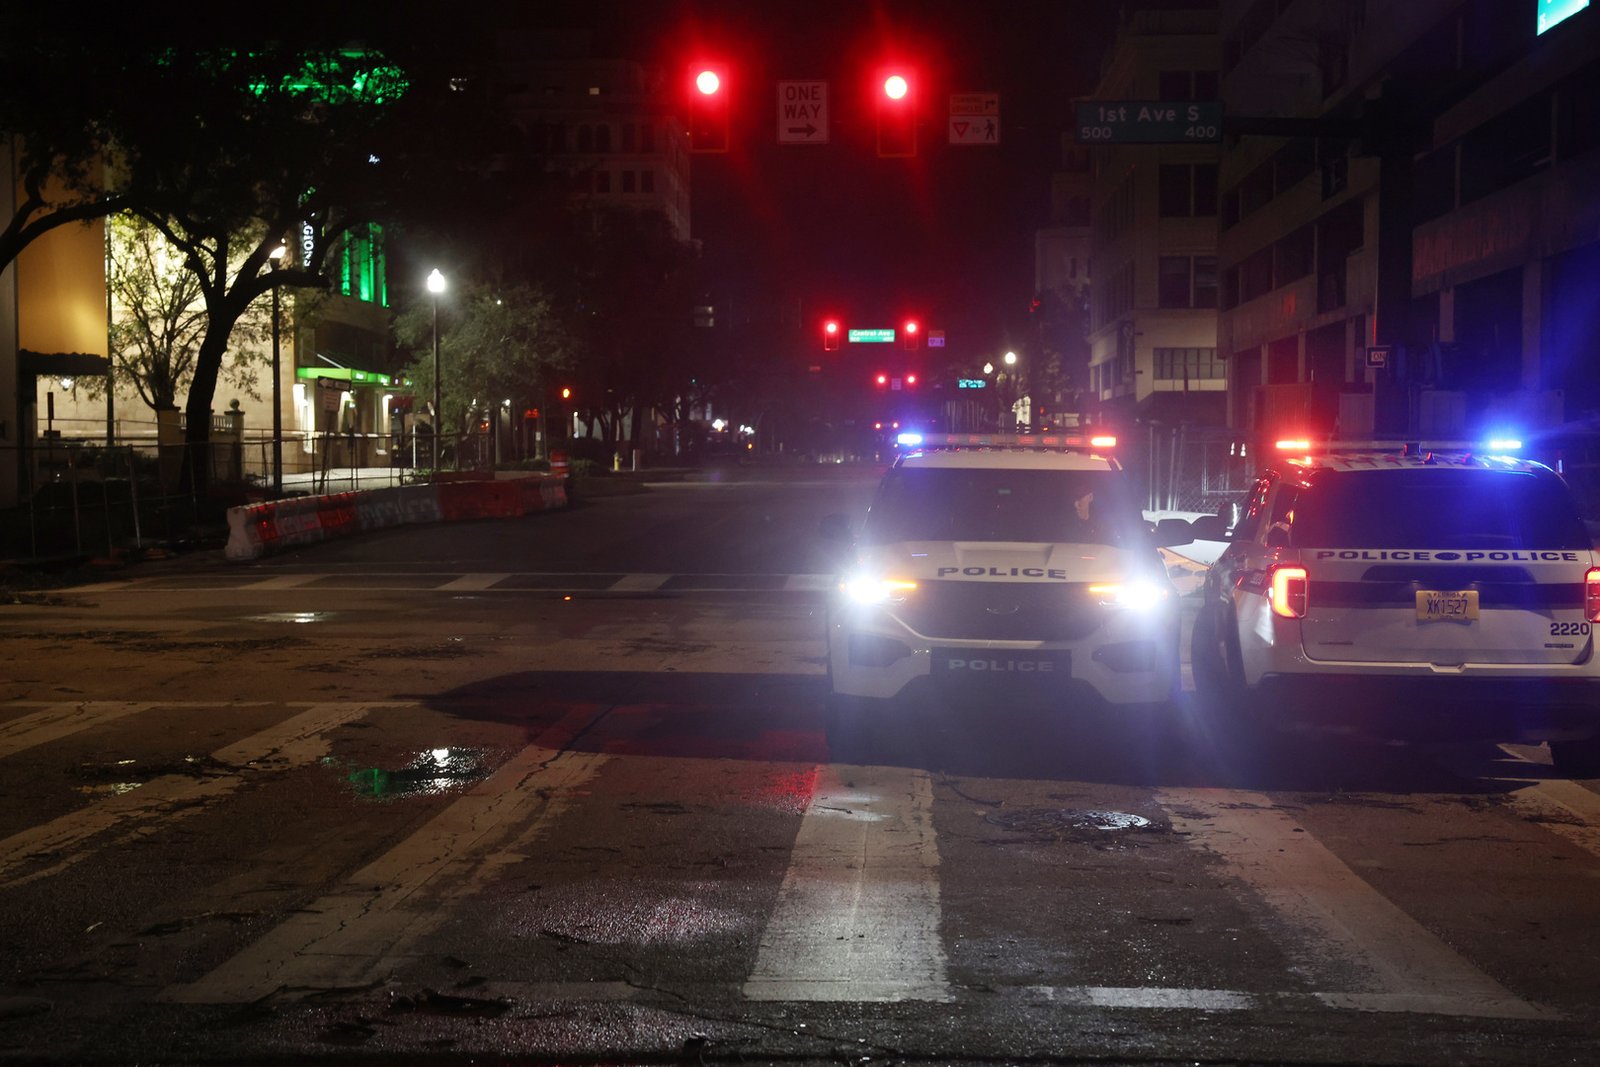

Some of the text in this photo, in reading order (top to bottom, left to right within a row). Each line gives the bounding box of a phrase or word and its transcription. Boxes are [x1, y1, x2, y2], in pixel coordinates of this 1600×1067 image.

[785, 85, 821, 101] ONE
[784, 103, 821, 120] WAY
[1098, 105, 1200, 122] 1st Ave S
[1081, 125, 1216, 139] 500 400
[1316, 551, 1431, 561] POLICE
[1466, 552, 1579, 561] POLICE
[938, 567, 1067, 580] POLICE
[1426, 599, 1469, 614] XK1527
[1550, 622, 1590, 636] 2220
[948, 659, 1055, 672] POLICE
